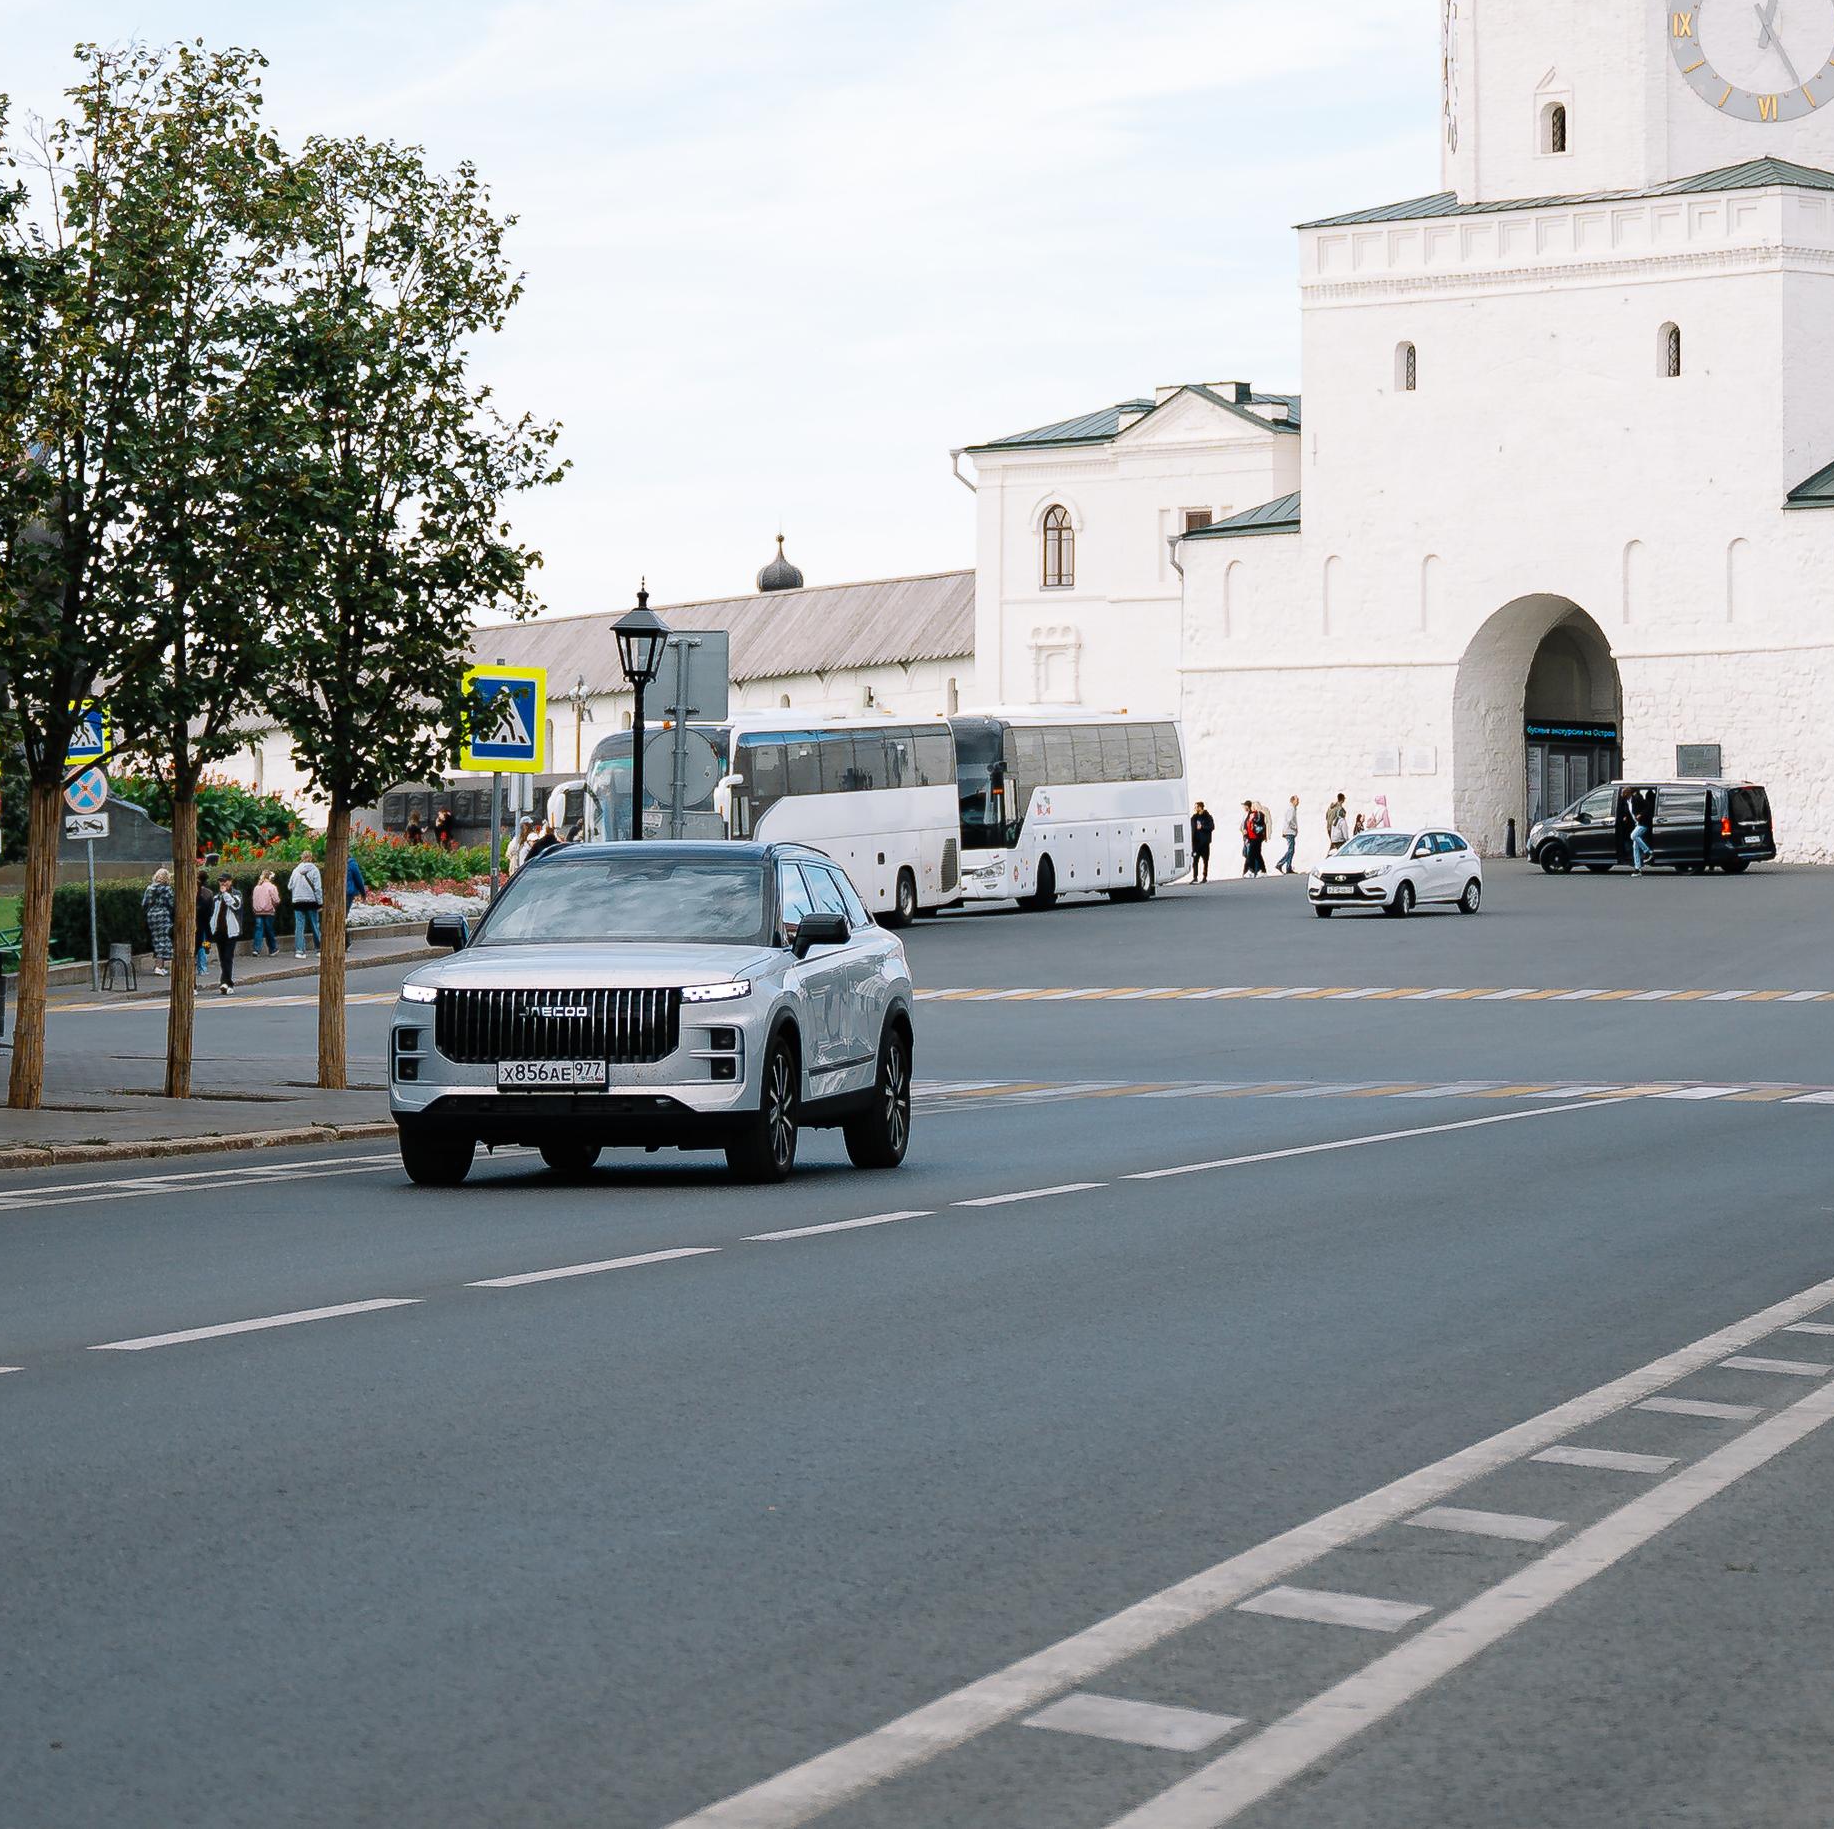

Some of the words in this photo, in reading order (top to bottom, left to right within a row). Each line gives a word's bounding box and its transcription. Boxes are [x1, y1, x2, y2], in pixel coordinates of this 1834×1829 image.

[1672, 12, 1693, 38] IX
[519, 1006, 588, 1018] JAECOO
[574, 1062, 601, 1076] 977
